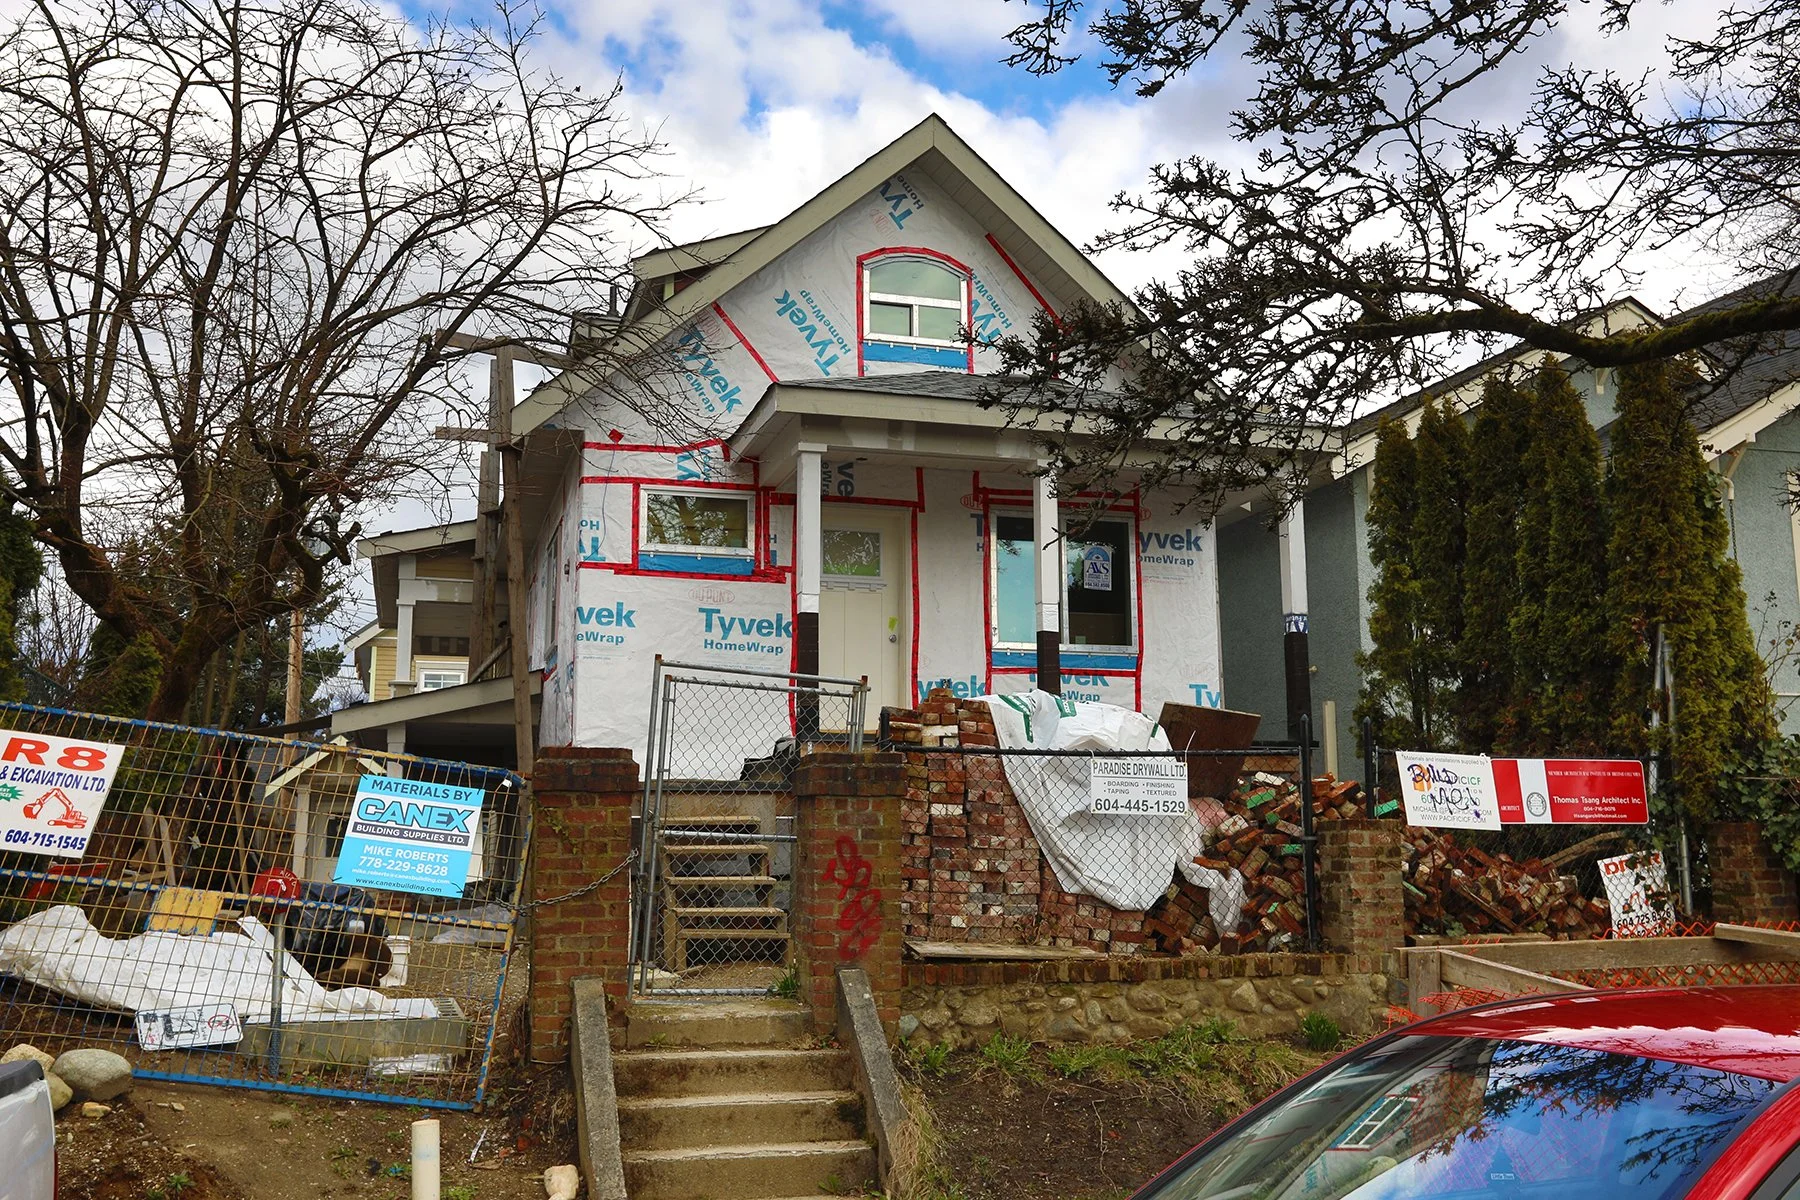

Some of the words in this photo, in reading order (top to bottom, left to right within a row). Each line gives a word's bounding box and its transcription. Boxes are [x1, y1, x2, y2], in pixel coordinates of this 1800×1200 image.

[800, 289, 851, 355] HomeWrap
[774, 289, 839, 377] Tyvek
[698, 607, 793, 641] Tyvek
[703, 640, 784, 655] HomeWrap
[10, 766, 83, 789] EXCAVATION
[82, 776, 106, 793] LTD.
[1093, 762, 1131, 776] PARADISE
[1133, 763, 1169, 777] DRYWALL
[1170, 764, 1187, 778] LTD.
[371, 779, 450, 799] MATERIALS
[453, 790, 473, 801] BY
[1094, 798, 1186, 813] 604-445-1529
[1553, 796, 1579, 804] Thomas
[1581, 796, 1600, 806] Tsang
[1602, 796, 1630, 804] Architect
[356, 797, 475, 834] CANEX
[356, 824, 400, 836] BUILDING
[402, 830, 445, 842] SUPPLIES
[447, 835, 465, 845] LTD.
[363, 844, 393, 856] MIKE
[395, 849, 449, 863] ROBERTS
[358, 856, 449, 876] 778-229-8628
[355, 877, 442, 893] www.canexbuilding.com
